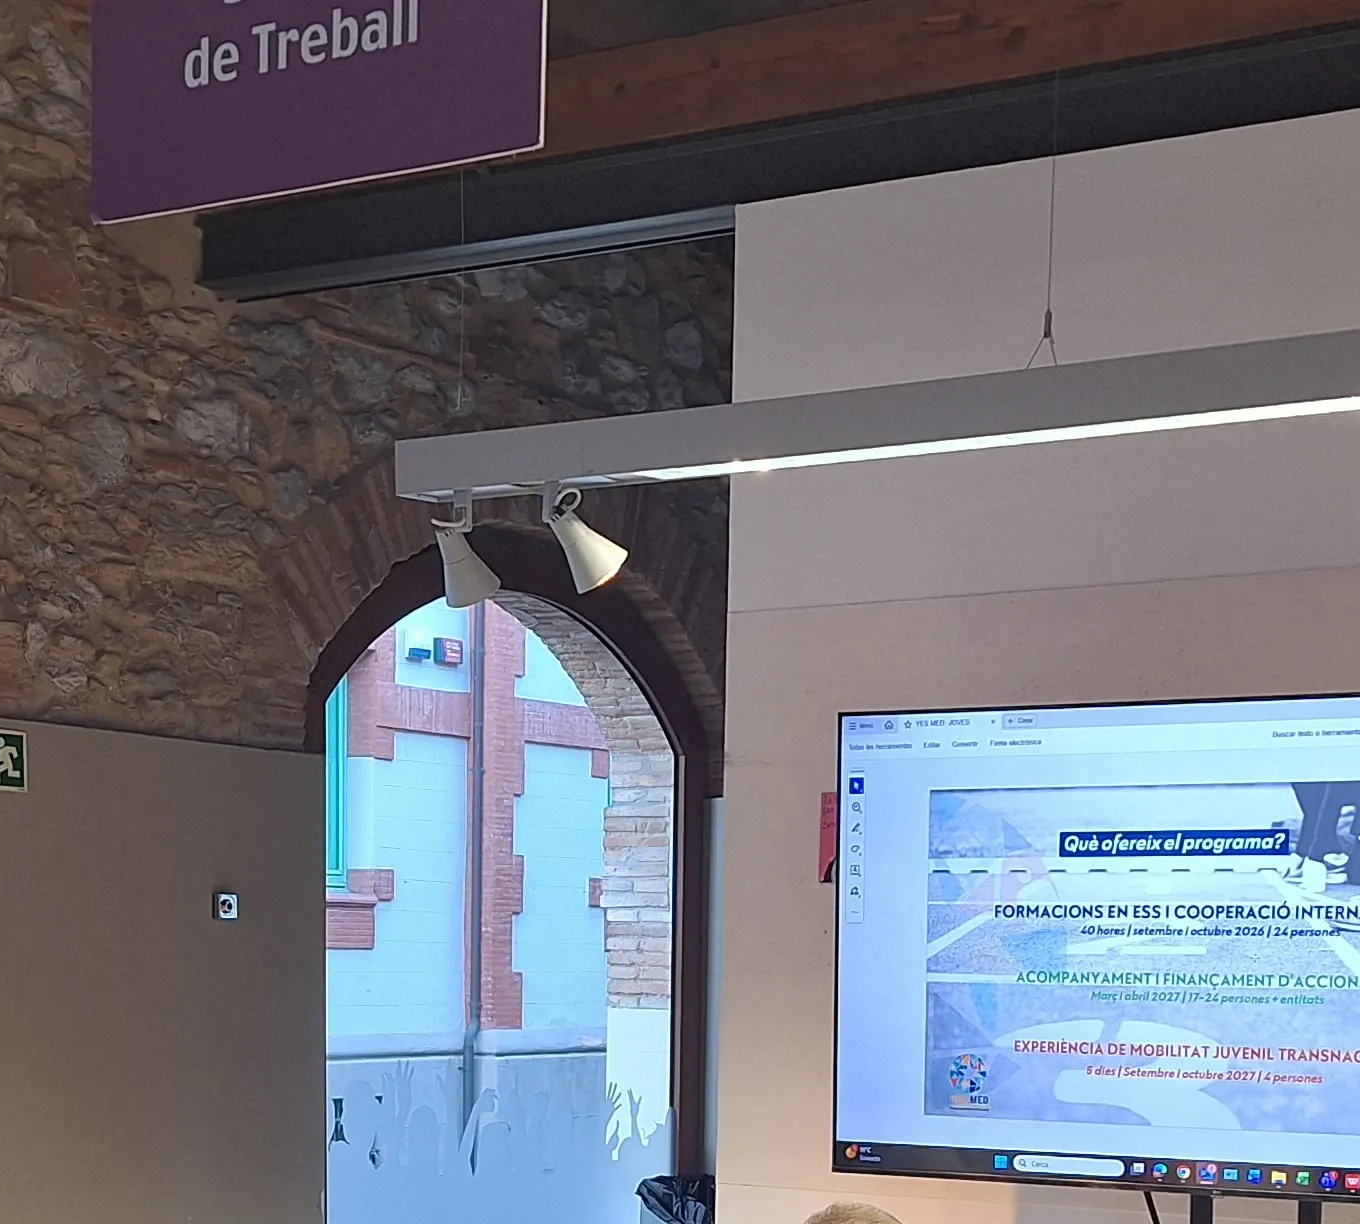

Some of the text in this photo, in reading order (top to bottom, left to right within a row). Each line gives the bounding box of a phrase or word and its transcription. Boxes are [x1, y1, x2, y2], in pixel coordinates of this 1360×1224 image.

[184, 0, 419, 89] de Treball
[1063, 832, 1286, 855] Què ofereix el programa?
[994, 904, 1104, 919] FORMACIONS
[1107, 904, 1129, 919] EN
[1133, 904, 1161, 919] ESS
[1174, 900, 1291, 920] COOPERACIÓ
[1080, 925, 1095, 936] 40
[1096, 925, 1125, 936] hores
[1132, 924, 1184, 936] setembre
[1190, 925, 1233, 937] octubre
[1234, 926, 1265, 937] 2026
[1273, 926, 1289, 937] 24
[1289, 926, 1341, 939] persones
[1016, 970, 1152, 985] ACOMPANYAMENT
[1163, 973, 1274, 990] FINANÇAMENT
[1091, 991, 1118, 1004] Març
[1124, 990, 1150, 1002] abril
[1151, 991, 1180, 1002] 2027
[1188, 992, 1220, 1003] 17-24
[1220, 995, 1270, 1006] persones
[1279, 995, 1325, 1005] entitats
[1014, 1038, 1104, 1055] EXPERIÈNCIA
[1107, 1043, 1127, 1056] DE
[1130, 1043, 1210, 1059] MOBILITAT
[1213, 1046, 1274, 1061] JUVENIL
[1093, 1065, 1116, 1077] dies
[1123, 1066, 1175, 1079] Setembre
[1182, 1068, 1224, 1080] octubre
[1225, 1071, 1255, 1081] 2027
[1263, 1072, 1272, 1082] 4
[1272, 1073, 1324, 1085] persones
[969, 1095, 989, 1105] MED
